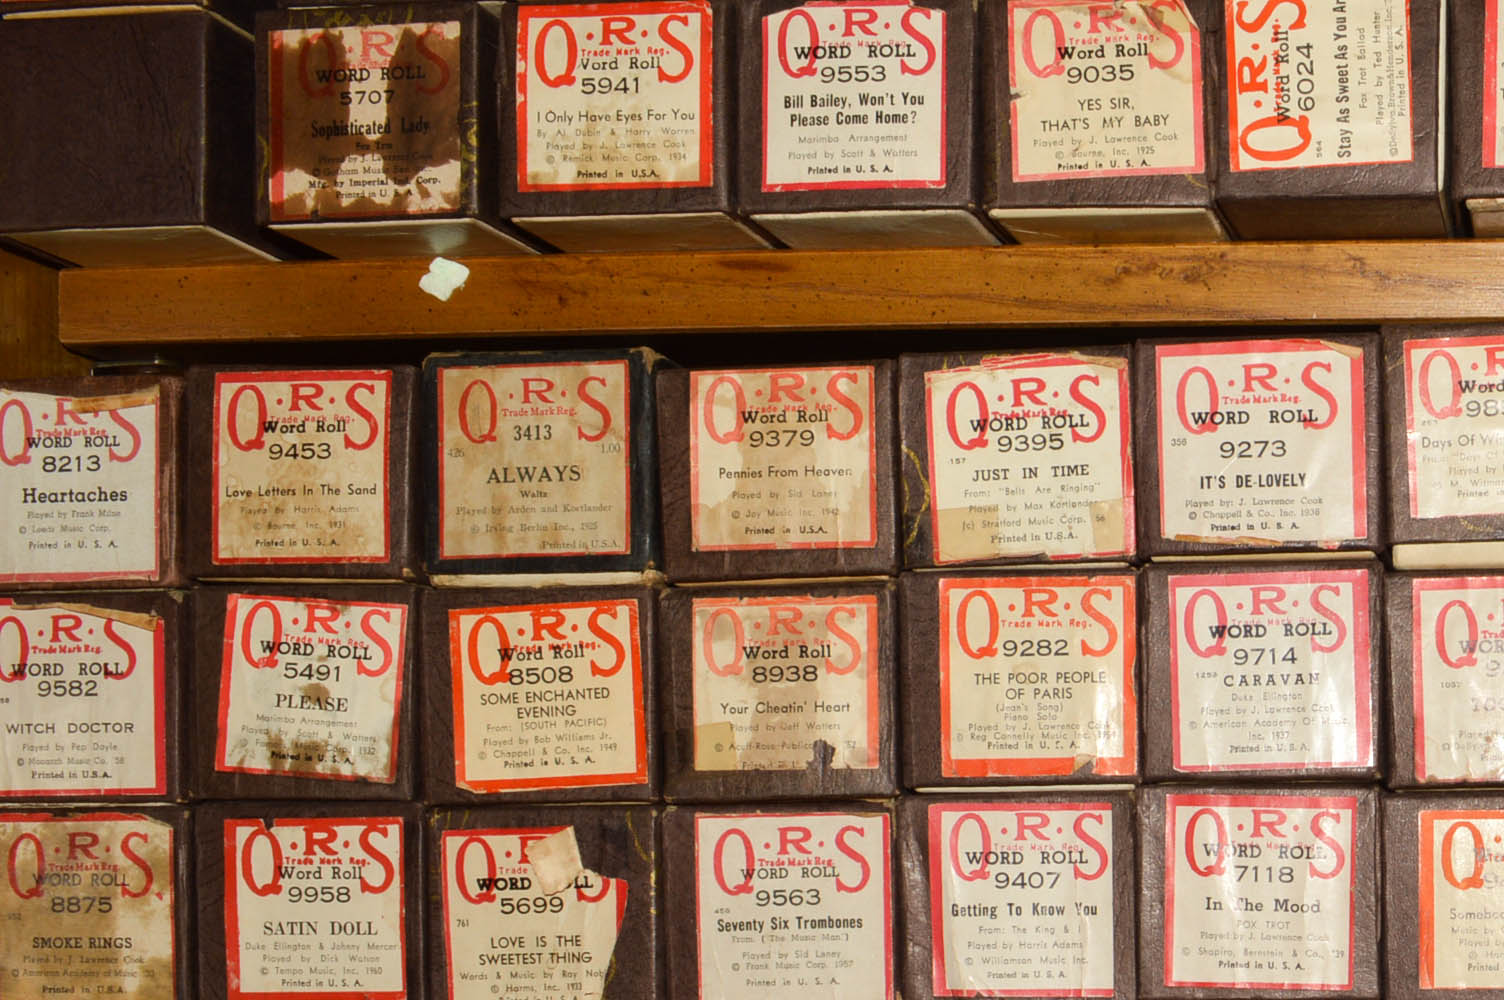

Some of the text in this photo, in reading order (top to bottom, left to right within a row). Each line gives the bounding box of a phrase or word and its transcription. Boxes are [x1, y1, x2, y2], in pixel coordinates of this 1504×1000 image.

[821, 65, 886, 83] 9553
[1296, 43, 1315, 111] 6024
[581, 77, 638, 94] 5941
[545, 111, 573, 125] Only
[579, 111, 611, 122] Have
[616, 110, 642, 124] Eyes
[647, 109, 666, 120] For
[672, 109, 694, 120] You
[312, 120, 391, 138] Sophisticated
[514, 425, 551, 441] 3413
[998, 433, 1064, 452] 9395
[1220, 440, 1286, 458] 9273
[42, 455, 100, 472] 8213
[487, 465, 580, 484] ALWAYS
[1201, 473, 1305, 489] IT'S DE-LOVELY
[23, 487, 127, 503] Heartaches
[520, 490, 547, 498] Waltz
[1003, 639, 1069, 657] 9282
[1234, 647, 1297, 665] 9714
[509, 666, 573, 685] 8508
[1224, 673, 1319, 687] CARAVAN
[38, 680, 98, 697] 9582
[275, 689, 348, 712] PLEASE
[6, 723, 134, 734] WITCH DOCTOR
[995, 872, 1060, 889] 9407
[288, 887, 350, 903] 9958
[756, 889, 820, 906] 9563
[51, 896, 112, 913] 8875
[264, 921, 377, 935] SATIN DOLL
